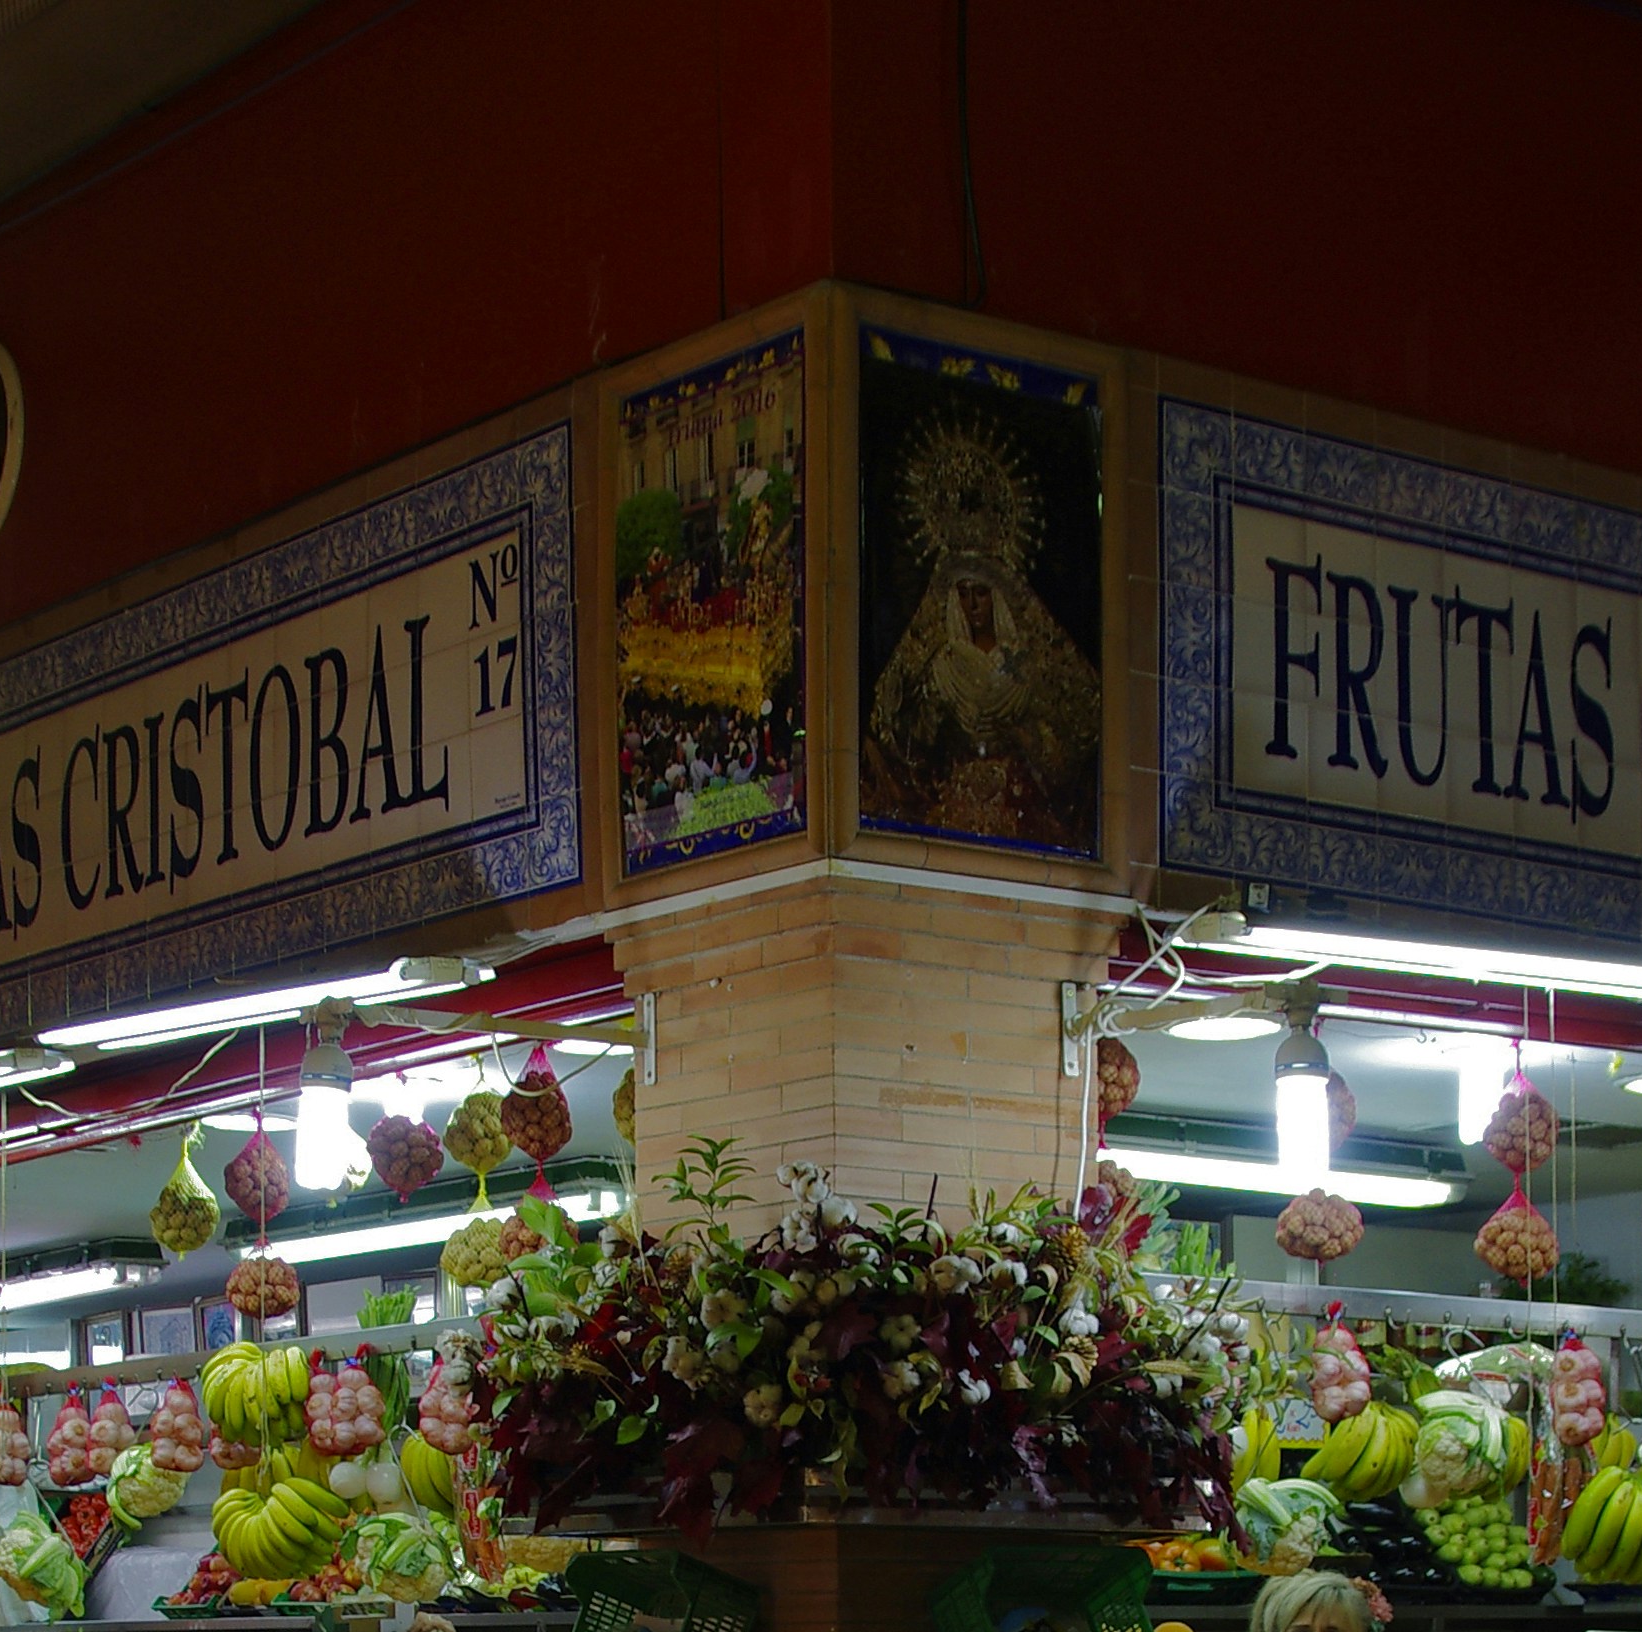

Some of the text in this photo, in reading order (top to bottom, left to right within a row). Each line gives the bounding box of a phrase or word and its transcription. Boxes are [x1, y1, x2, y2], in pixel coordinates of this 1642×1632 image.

[60, 614, 450, 911] CRISTOBAL
[474, 637, 519, 718] 17
[1265, 553, 1615, 825] FRUTAS
